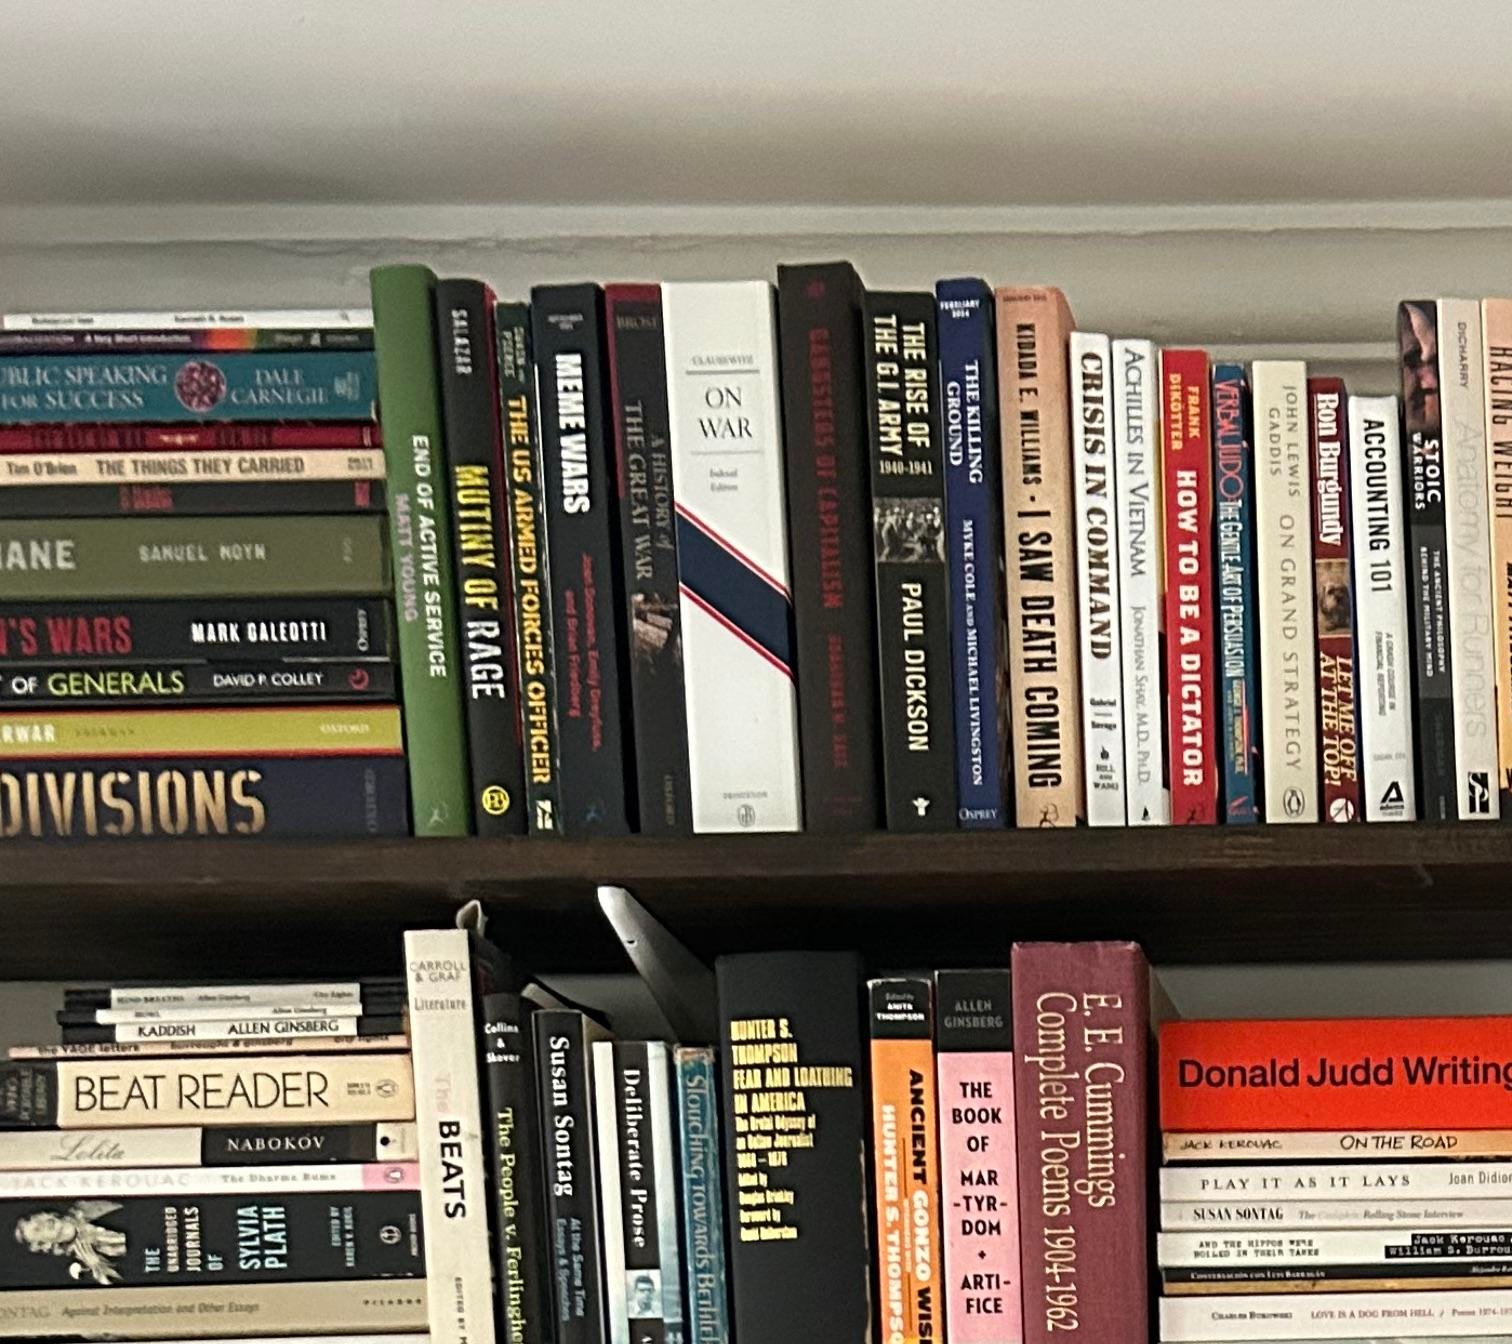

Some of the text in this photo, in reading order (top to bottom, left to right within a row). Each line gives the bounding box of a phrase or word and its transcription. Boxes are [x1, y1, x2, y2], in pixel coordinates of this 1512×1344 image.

[705, 387, 743, 410] ON
[555, 354, 590, 513] MEME WARS
[699, 418, 753, 440] WAR
[96, 458, 305, 474] THE THINGS THEY CARRIED
[1363, 419, 1391, 593] ACCOUNTING 101
[413, 435, 447, 678] END OF ACTIVE SERVICE
[456, 465, 504, 699] MUTINY OF RAGE
[11, 671, 184, 695] OF GENERALS
[138, 1019, 338, 1037] KADDISH ALLEN GINSBERG
[74, 1071, 328, 1111] BEAT READER
[1178, 1060, 1300, 1089] Donald
[1306, 1057, 1393, 1088] Judd
[550, 1037, 574, 1196] Susan Sontag
[227, 1136, 325, 1153] NABOKOV
[1340, 1134, 1457, 1150] ON THE ROAD
[439, 1120, 466, 1221] BEATS
[1026, 992, 1079, 1333] Complete Poems 1904-1962
